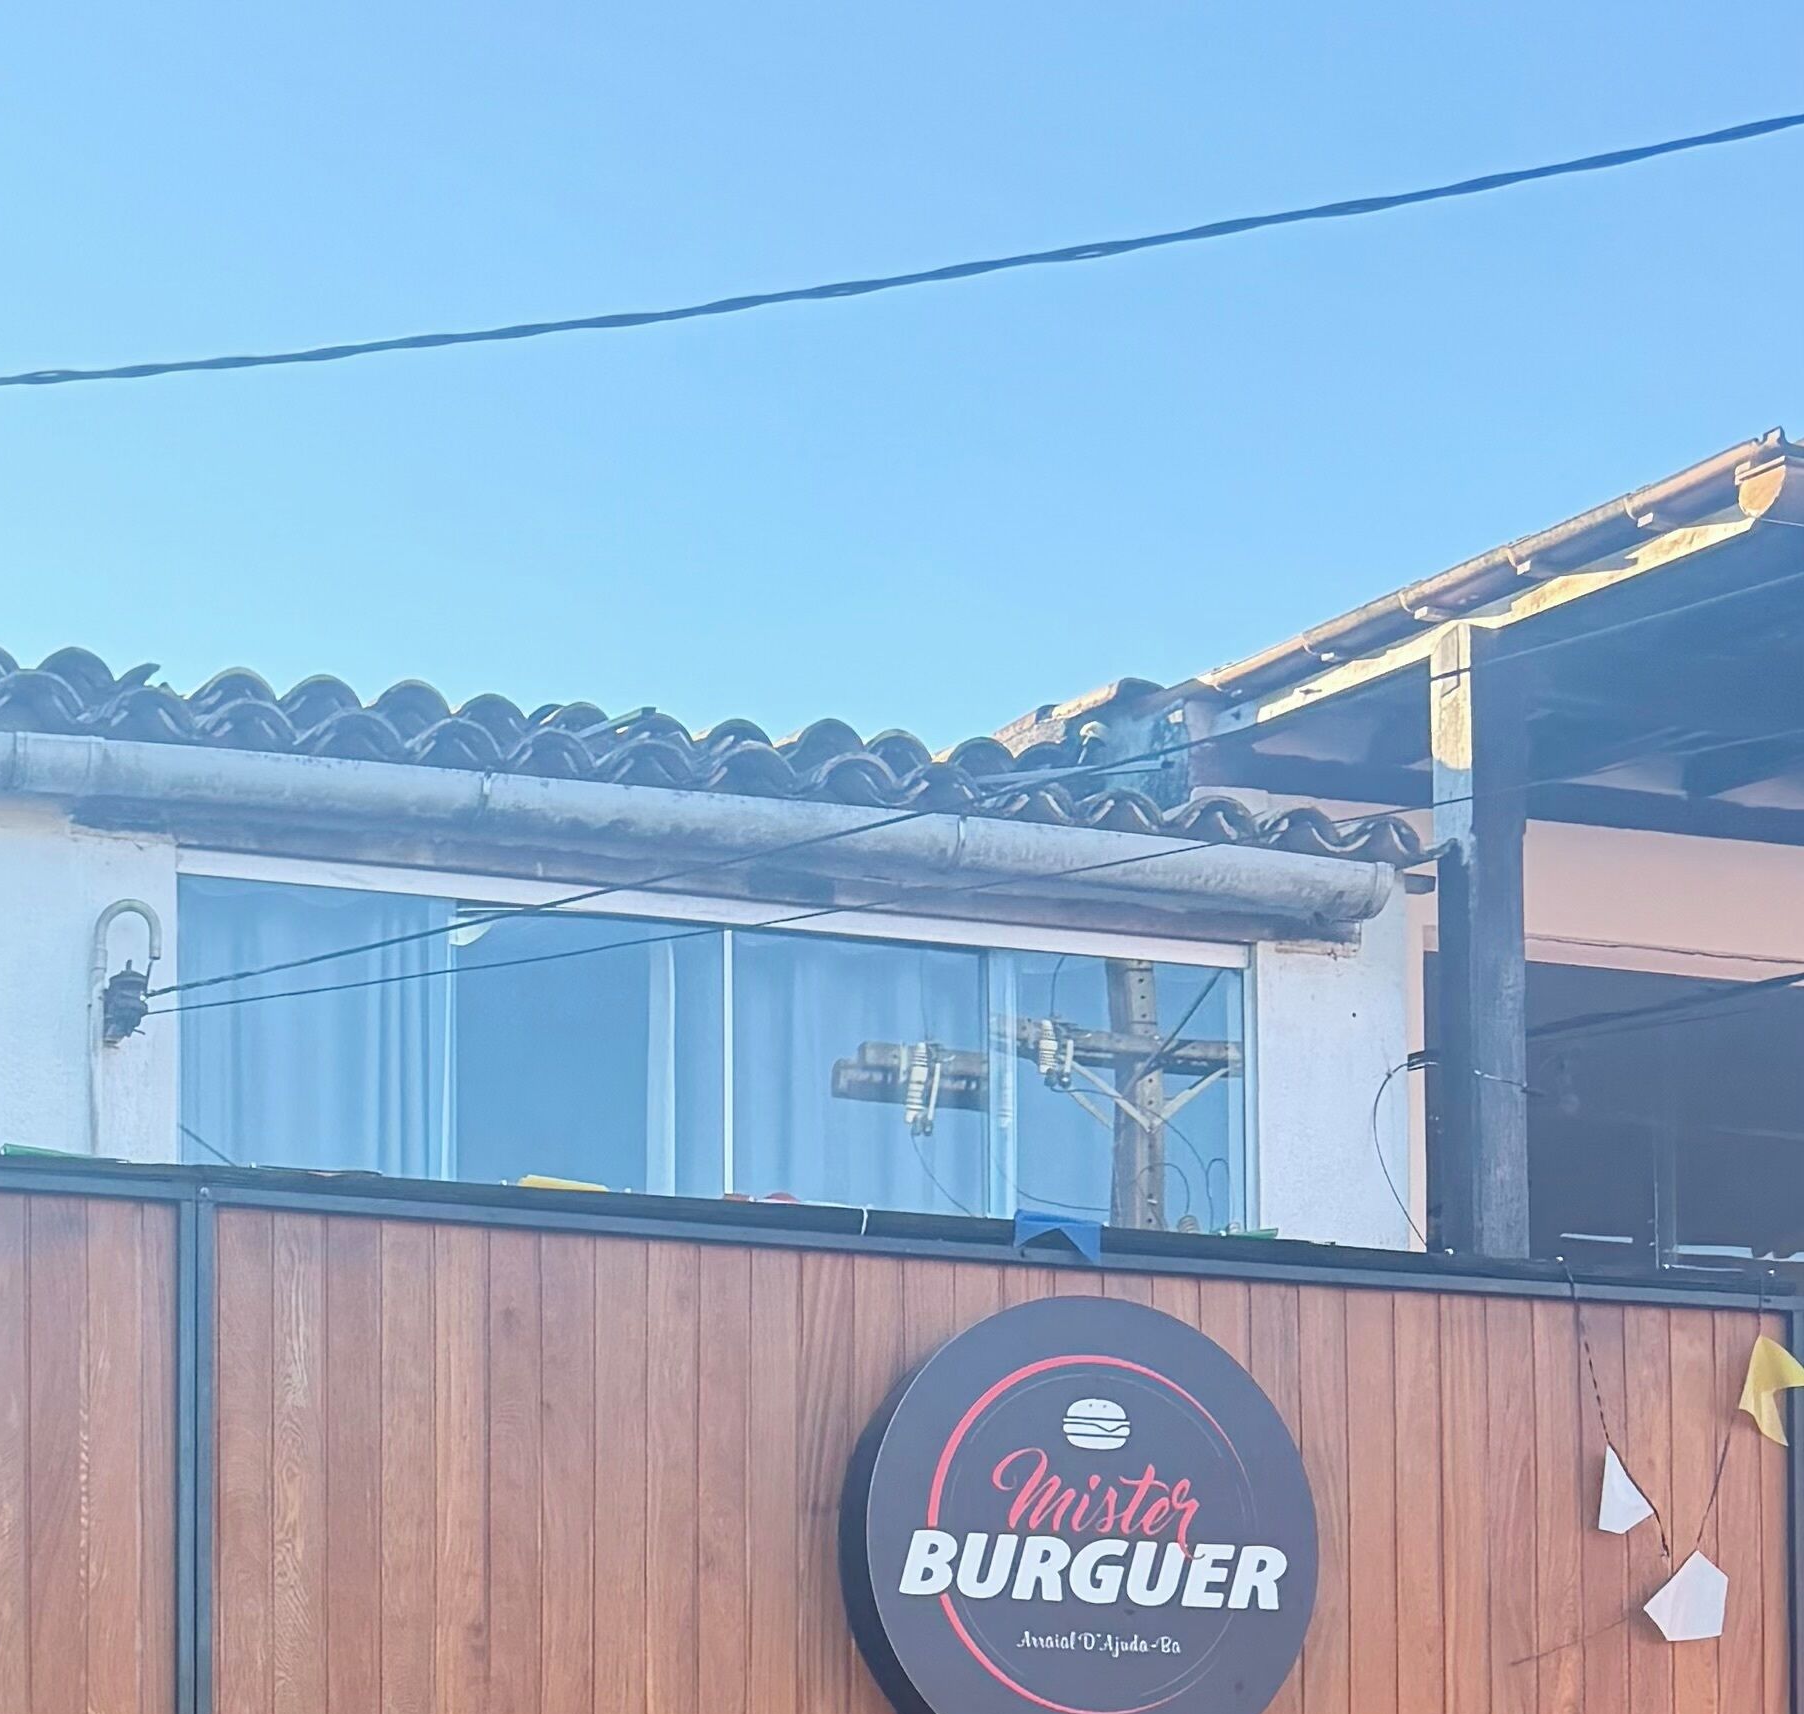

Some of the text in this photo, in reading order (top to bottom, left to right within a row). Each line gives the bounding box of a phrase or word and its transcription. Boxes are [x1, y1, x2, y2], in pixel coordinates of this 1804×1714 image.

[992, 1448, 1200, 1559] Mister
[899, 1529, 1287, 1610] BURGUER
[1016, 1630, 1076, 1649] Arraial
